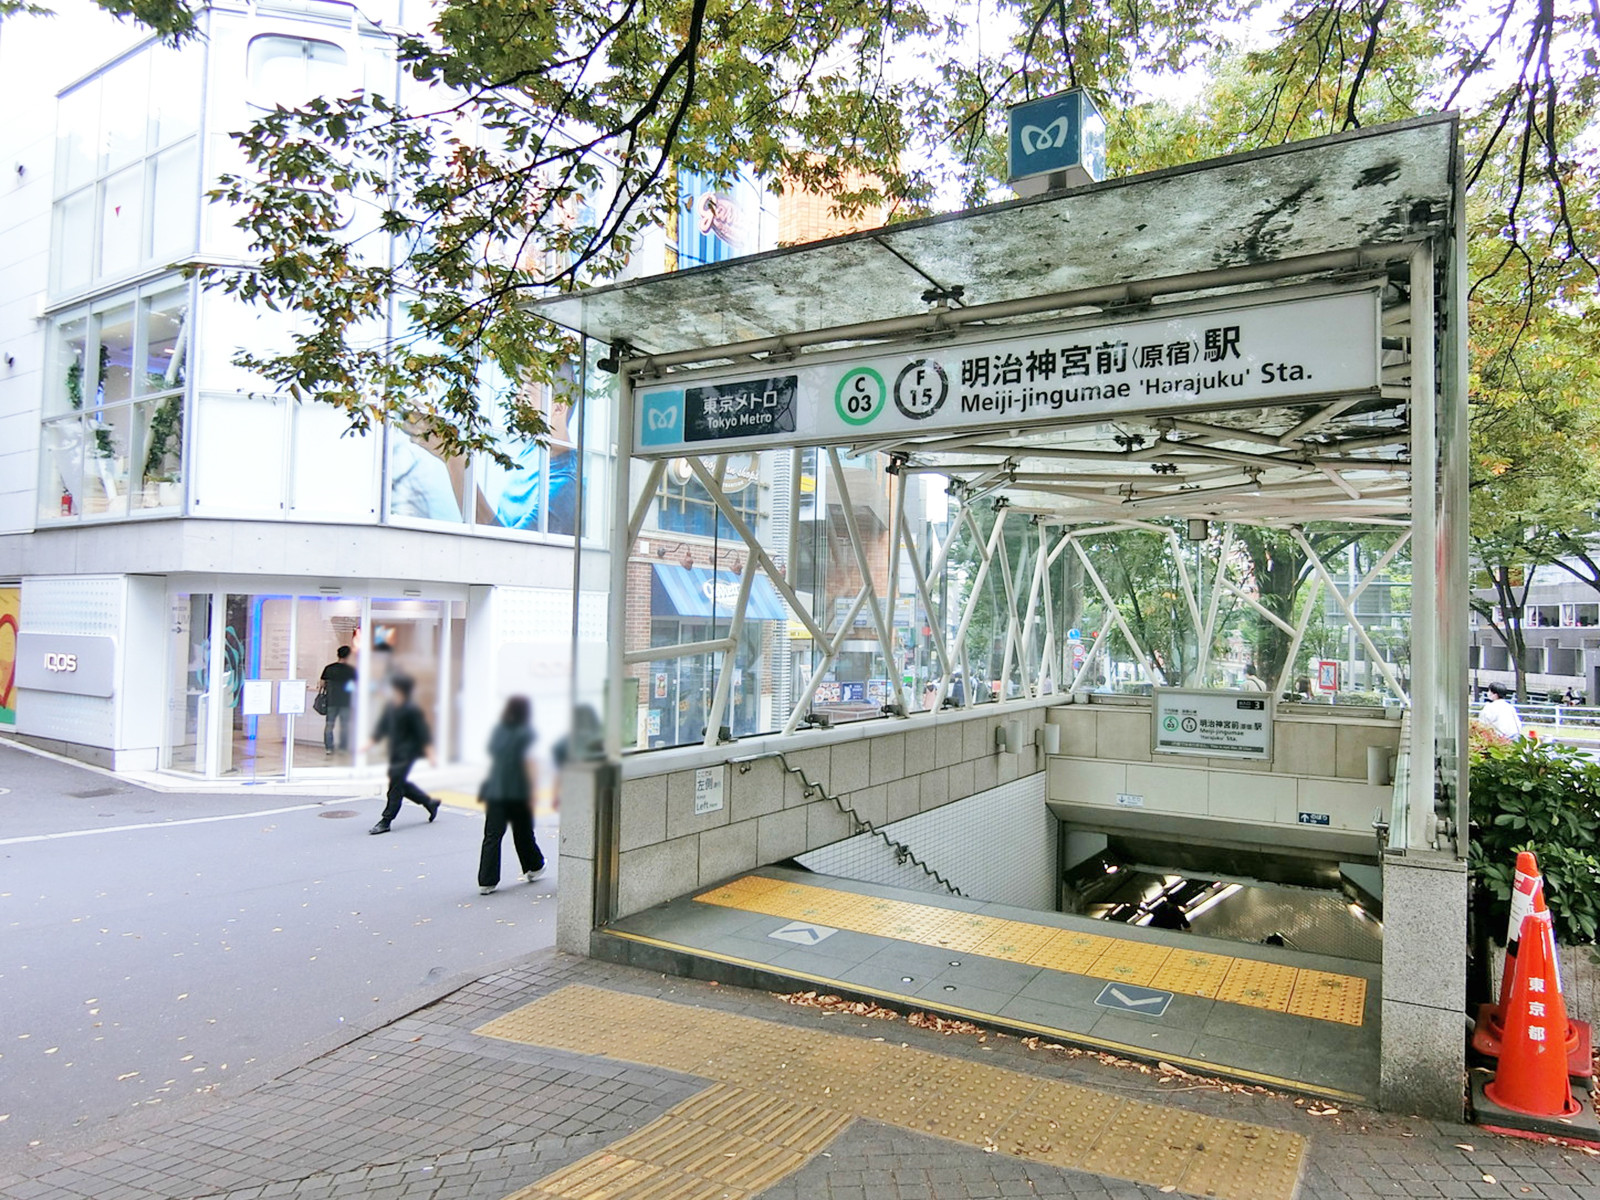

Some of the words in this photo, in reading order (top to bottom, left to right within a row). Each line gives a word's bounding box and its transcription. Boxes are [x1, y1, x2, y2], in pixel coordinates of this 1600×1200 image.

[854, 376, 866, 393] C
[916, 370, 926, 387] F
[911, 388, 932, 407] 15
[961, 381, 1131, 415] Meiji-jingumae
[1140, 369, 1250, 395] 'Harajuku'
[1261, 362, 1313, 384] Sta.
[703, 391, 778, 415] 東京メトロ
[847, 395, 872, 414] 03
[707, 415, 737, 430] Tokyo
[739, 412, 773, 426] Metro
[43, 652, 78, 673] IQOS
[1528, 977, 1545, 1041] 東京都
